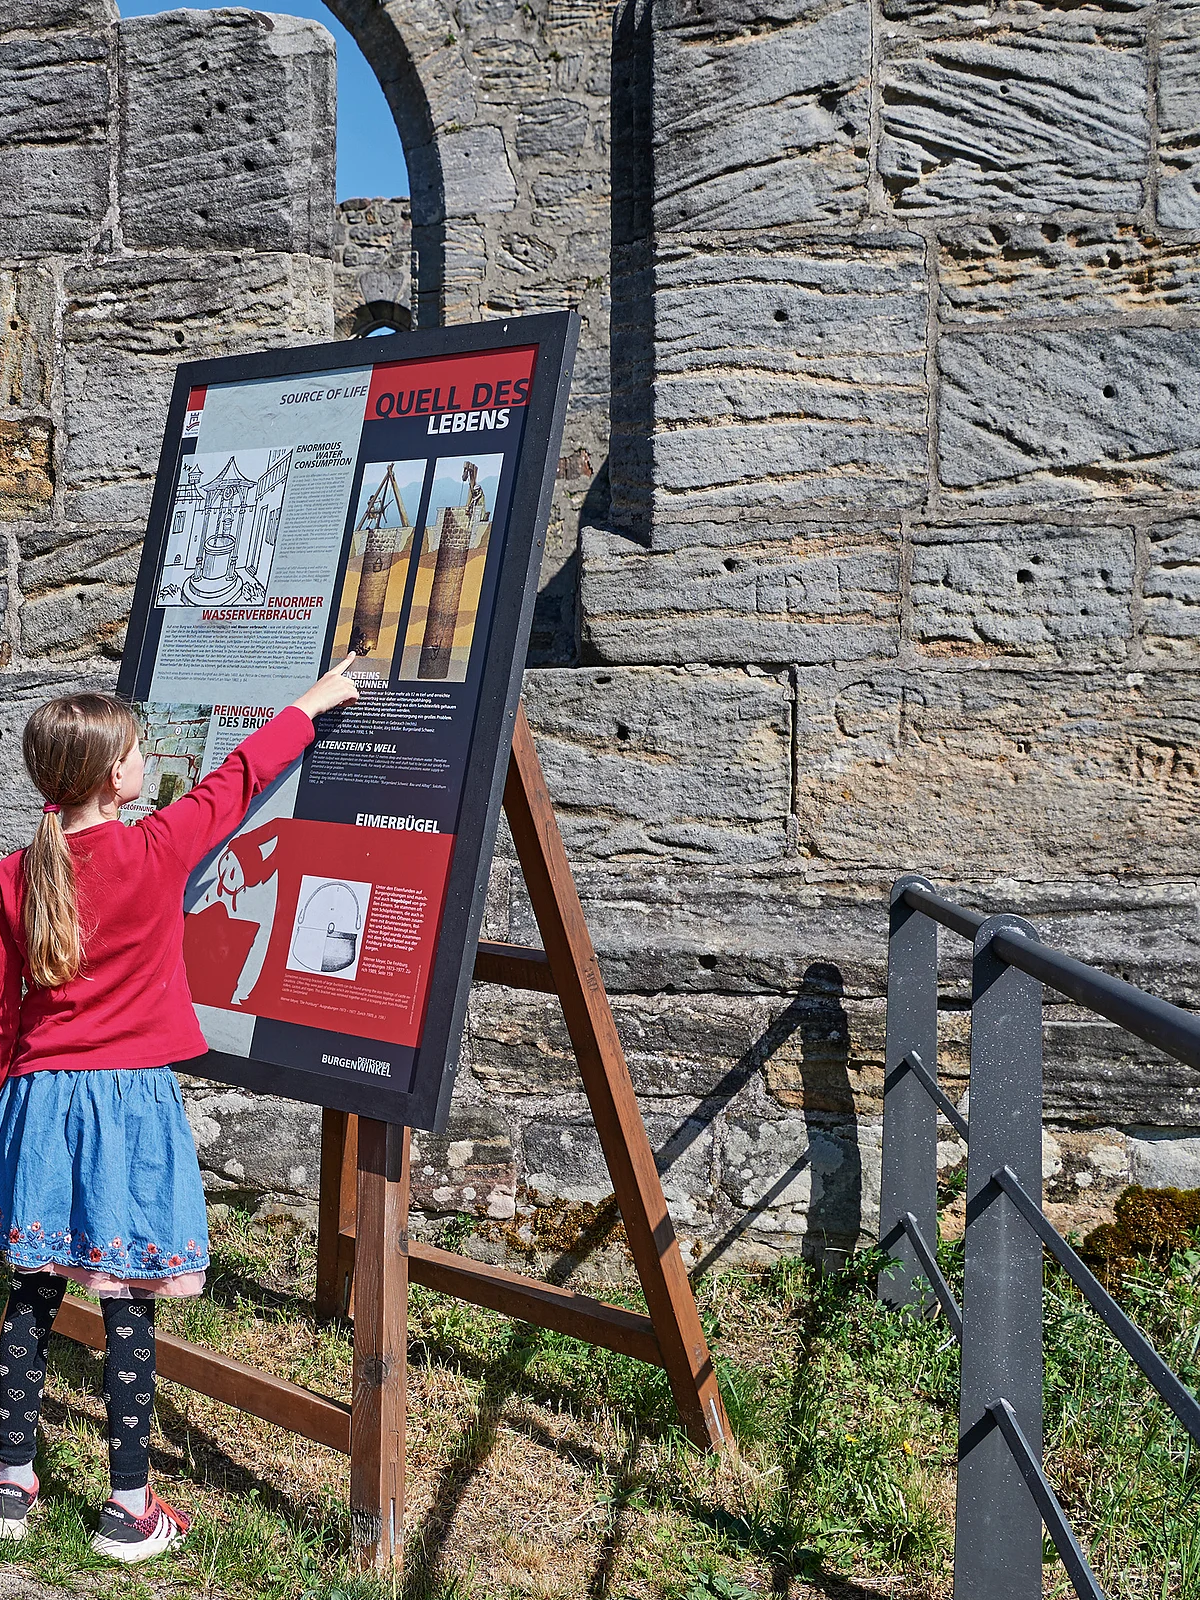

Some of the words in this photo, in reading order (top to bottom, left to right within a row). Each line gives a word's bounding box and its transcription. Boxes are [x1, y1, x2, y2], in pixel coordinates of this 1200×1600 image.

[279, 390, 323, 405] SOURCE
[325, 388, 342, 400] OF
[343, 385, 368, 399] LIFE
[375, 385, 461, 418] QUELL
[471, 378, 529, 407] DES
[427, 408, 511, 435] LEBENS
[296, 441, 342, 453] ENORMOUS
[315, 450, 343, 460] WATER
[294, 457, 353, 469] CONSUMPTION
[267, 596, 324, 608] ENORMER
[202, 609, 312, 620] WASSERVERBRAUCH
[343, 671, 380, 680] ENSTEINS
[354, 680, 389, 689] RUNNEN
[213, 705, 275, 718] REINIGUNG
[218, 717, 240, 728] DES
[242, 718, 272, 729] BRU
[373, 743, 397, 753] WELL
[355, 813, 440, 834] EIMERBÜGEL
[321, 1054, 392, 1078] BURGENWINKEL
